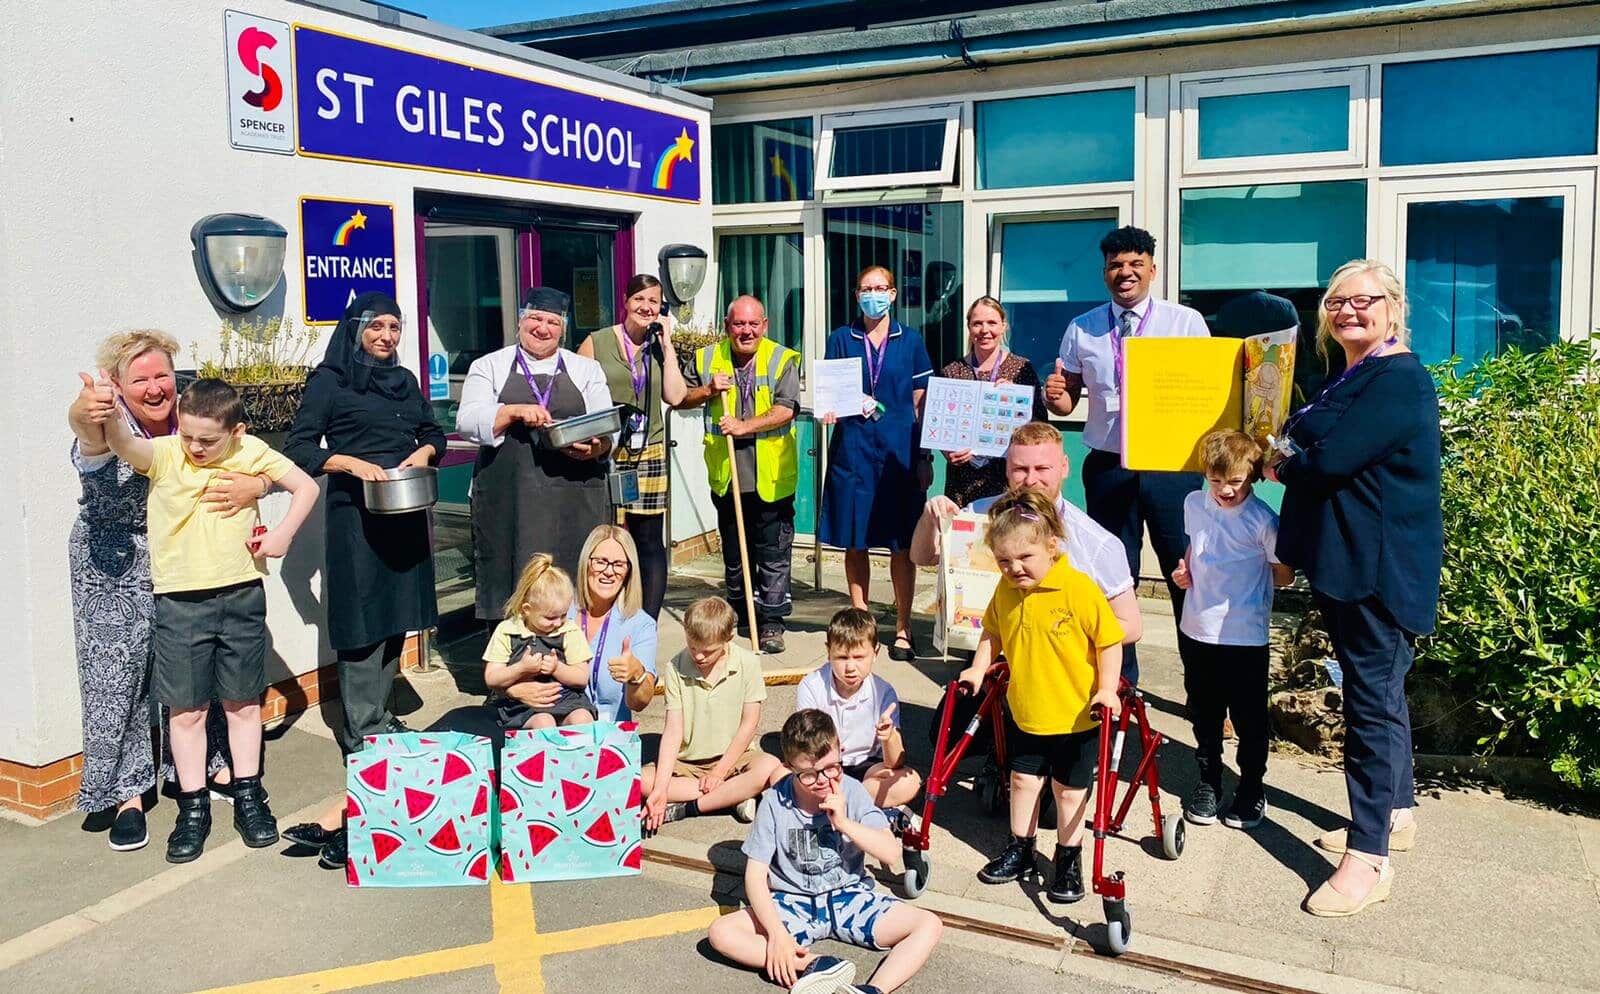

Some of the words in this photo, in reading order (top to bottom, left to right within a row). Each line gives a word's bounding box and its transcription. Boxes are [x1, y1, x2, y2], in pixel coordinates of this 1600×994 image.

[240, 118, 286, 134] SPENCER
[315, 67, 375, 125] ST
[395, 84, 505, 147] GILES
[521, 109, 642, 169] SCHOOL
[306, 255, 393, 279] ENTRANCE
